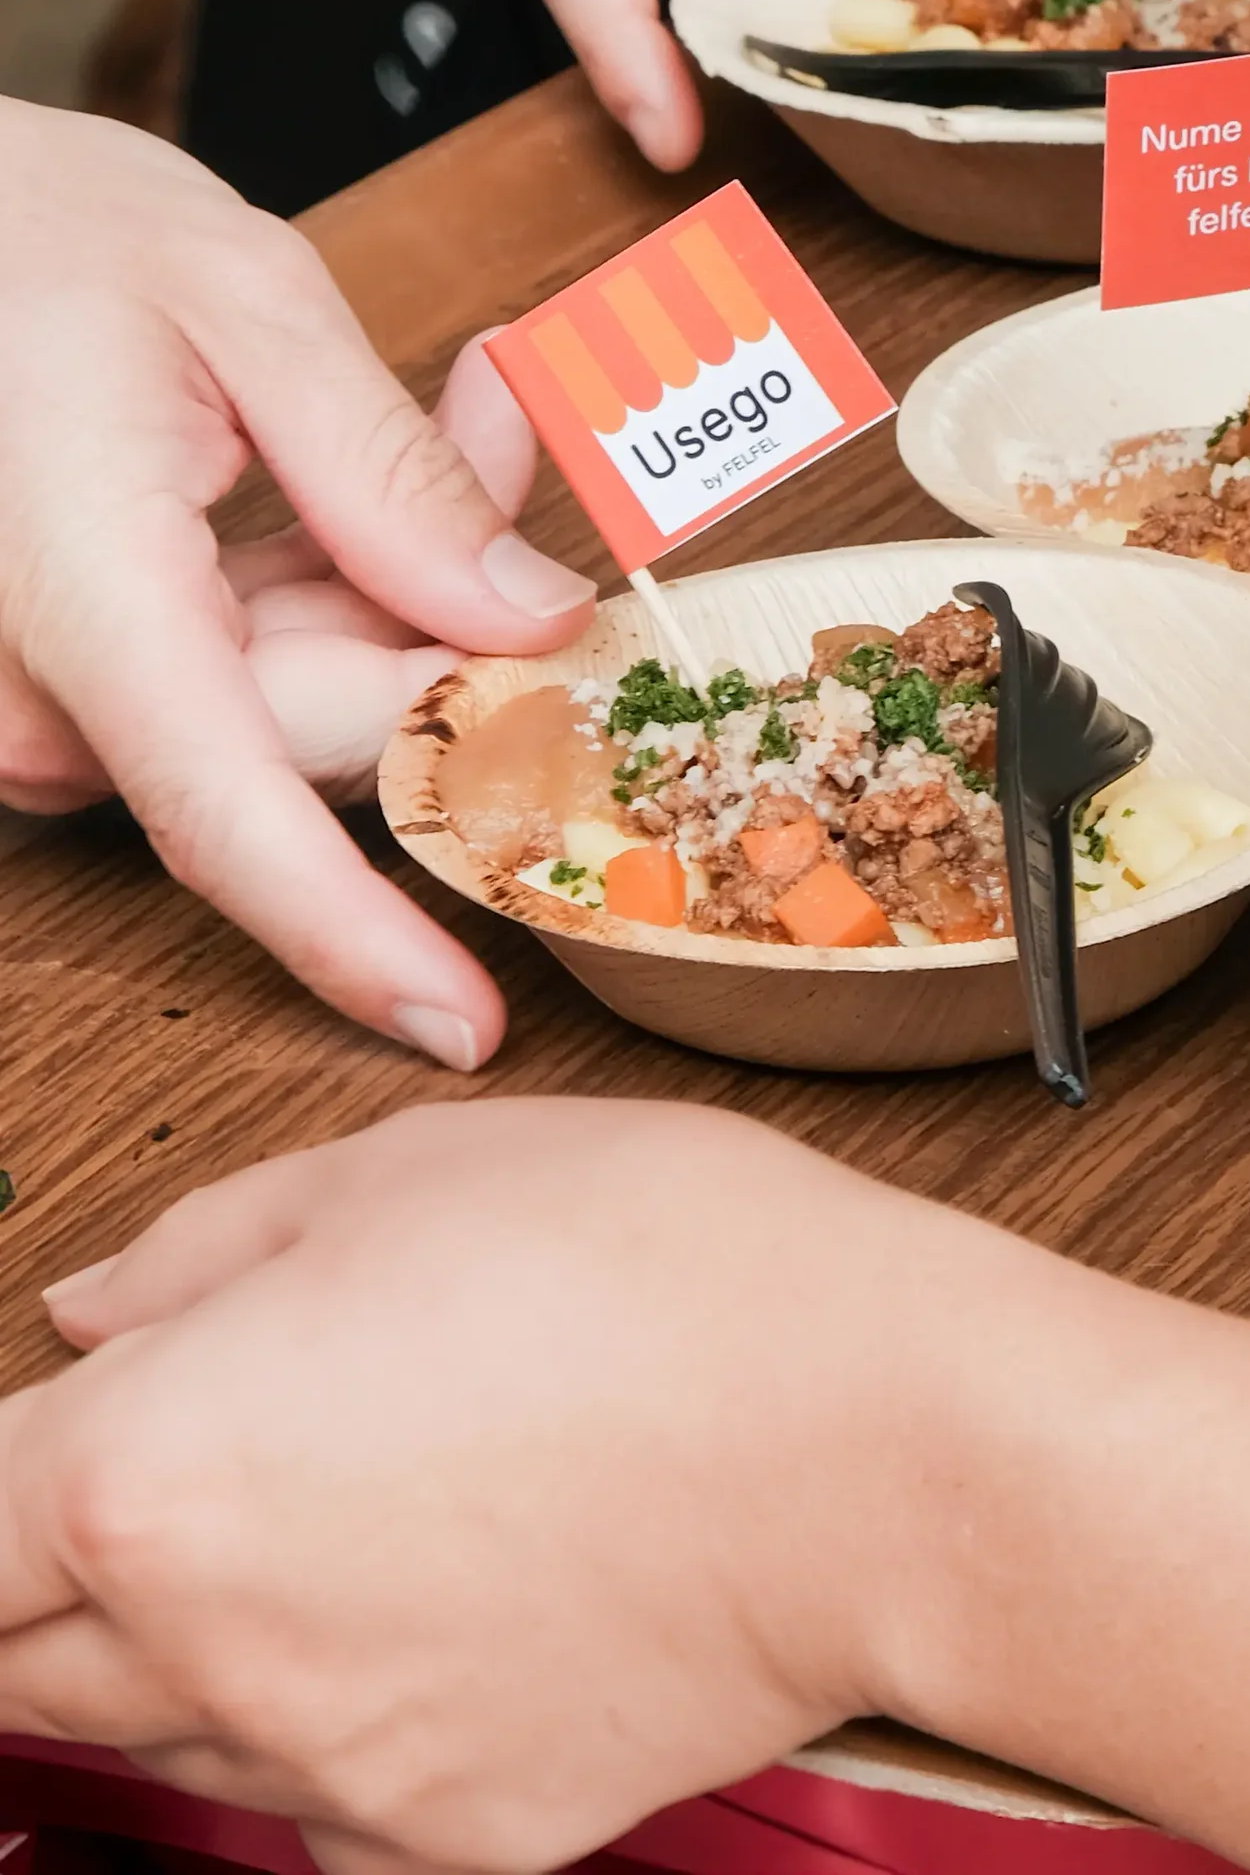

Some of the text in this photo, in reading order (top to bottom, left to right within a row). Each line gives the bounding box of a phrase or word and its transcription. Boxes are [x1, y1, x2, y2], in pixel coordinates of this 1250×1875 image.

[1140, 119, 1242, 153] Nume
[1174, 164, 1238, 194] fürs
[631, 370, 792, 479] Usego
[700, 436, 781, 490] by FELFEL
